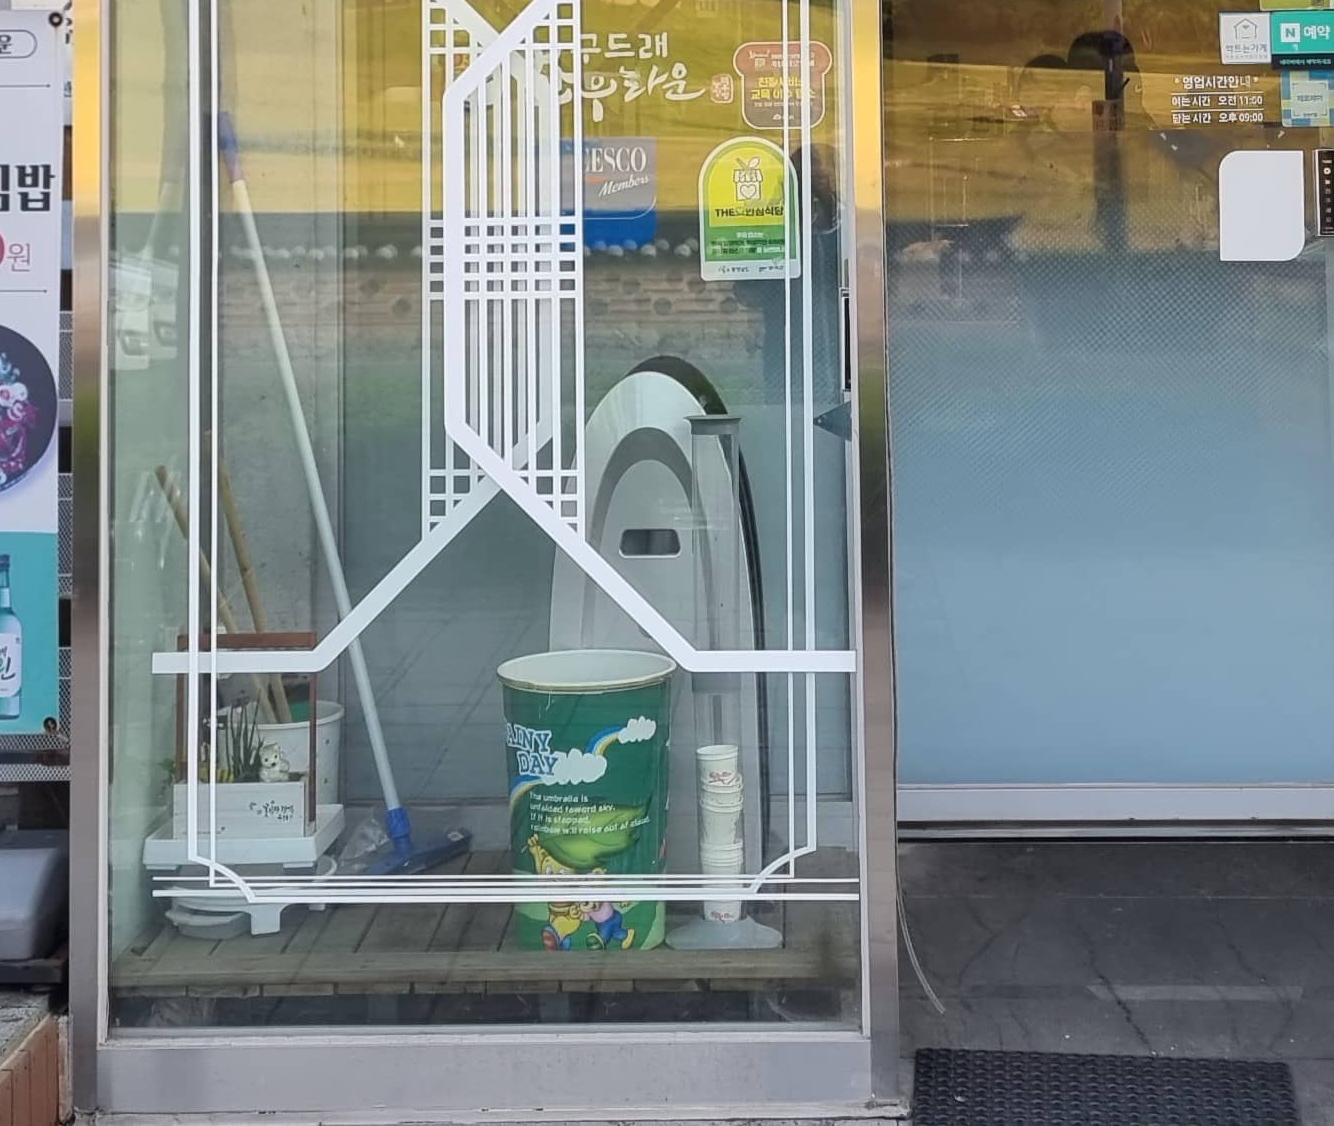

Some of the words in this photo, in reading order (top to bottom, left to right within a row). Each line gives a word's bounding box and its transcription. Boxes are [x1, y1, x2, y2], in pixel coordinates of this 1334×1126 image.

[1304, 25, 1331, 40] 예약
[1183, 75, 1251, 90] 영업시간안내
[1218, 92, 1236, 106] 오전
[1218, 111, 1237, 123] 오후
[1238, 111, 1264, 123] 09:00
[598, 175, 650, 197] Members
[517, 751, 558, 776] DAY
[581, 793, 588, 802] is
